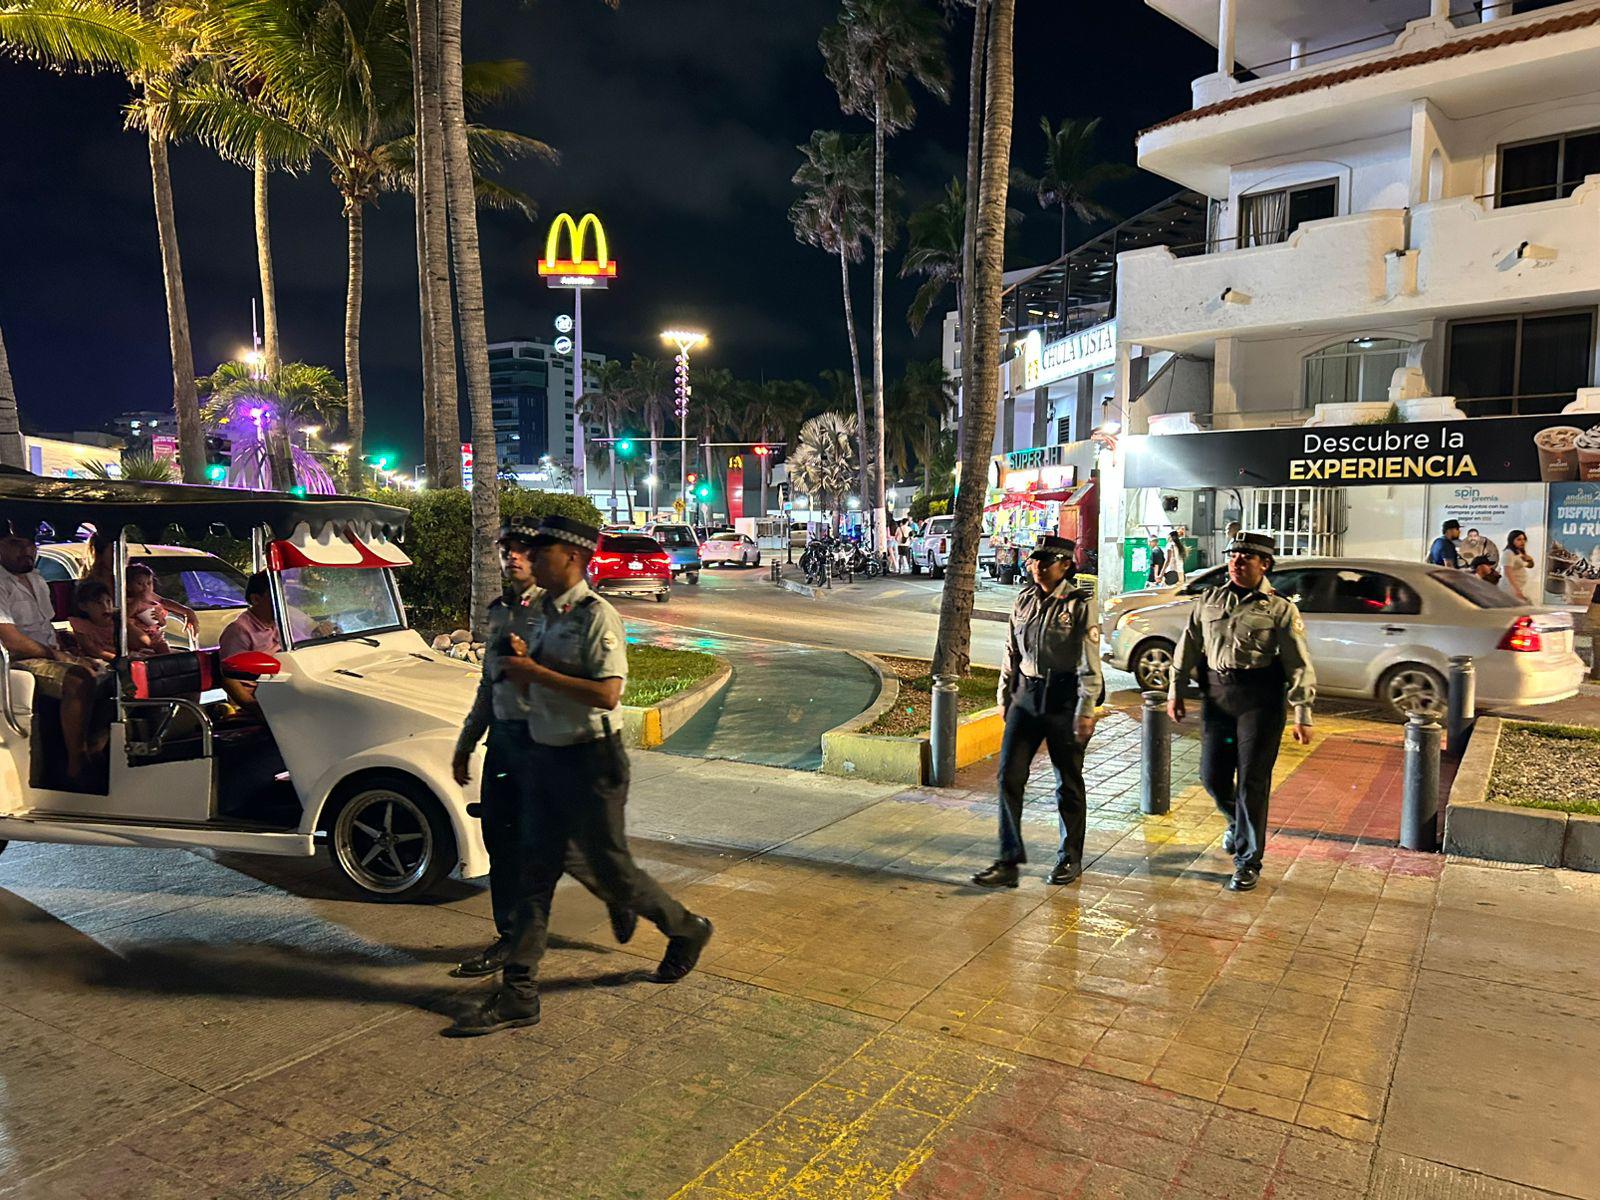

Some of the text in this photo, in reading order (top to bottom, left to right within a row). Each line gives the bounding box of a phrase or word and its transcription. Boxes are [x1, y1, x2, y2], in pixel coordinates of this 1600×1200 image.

[1042, 335, 1076, 370] CHULA
[1079, 323, 1113, 359] VISTA
[1304, 427, 1464, 453] Descubre la
[1010, 449, 1044, 470] SUPER
[1289, 454, 1478, 480] EXPERIENCIA
[1455, 486, 1480, 500] spin
[1563, 523, 1577, 535] LO
